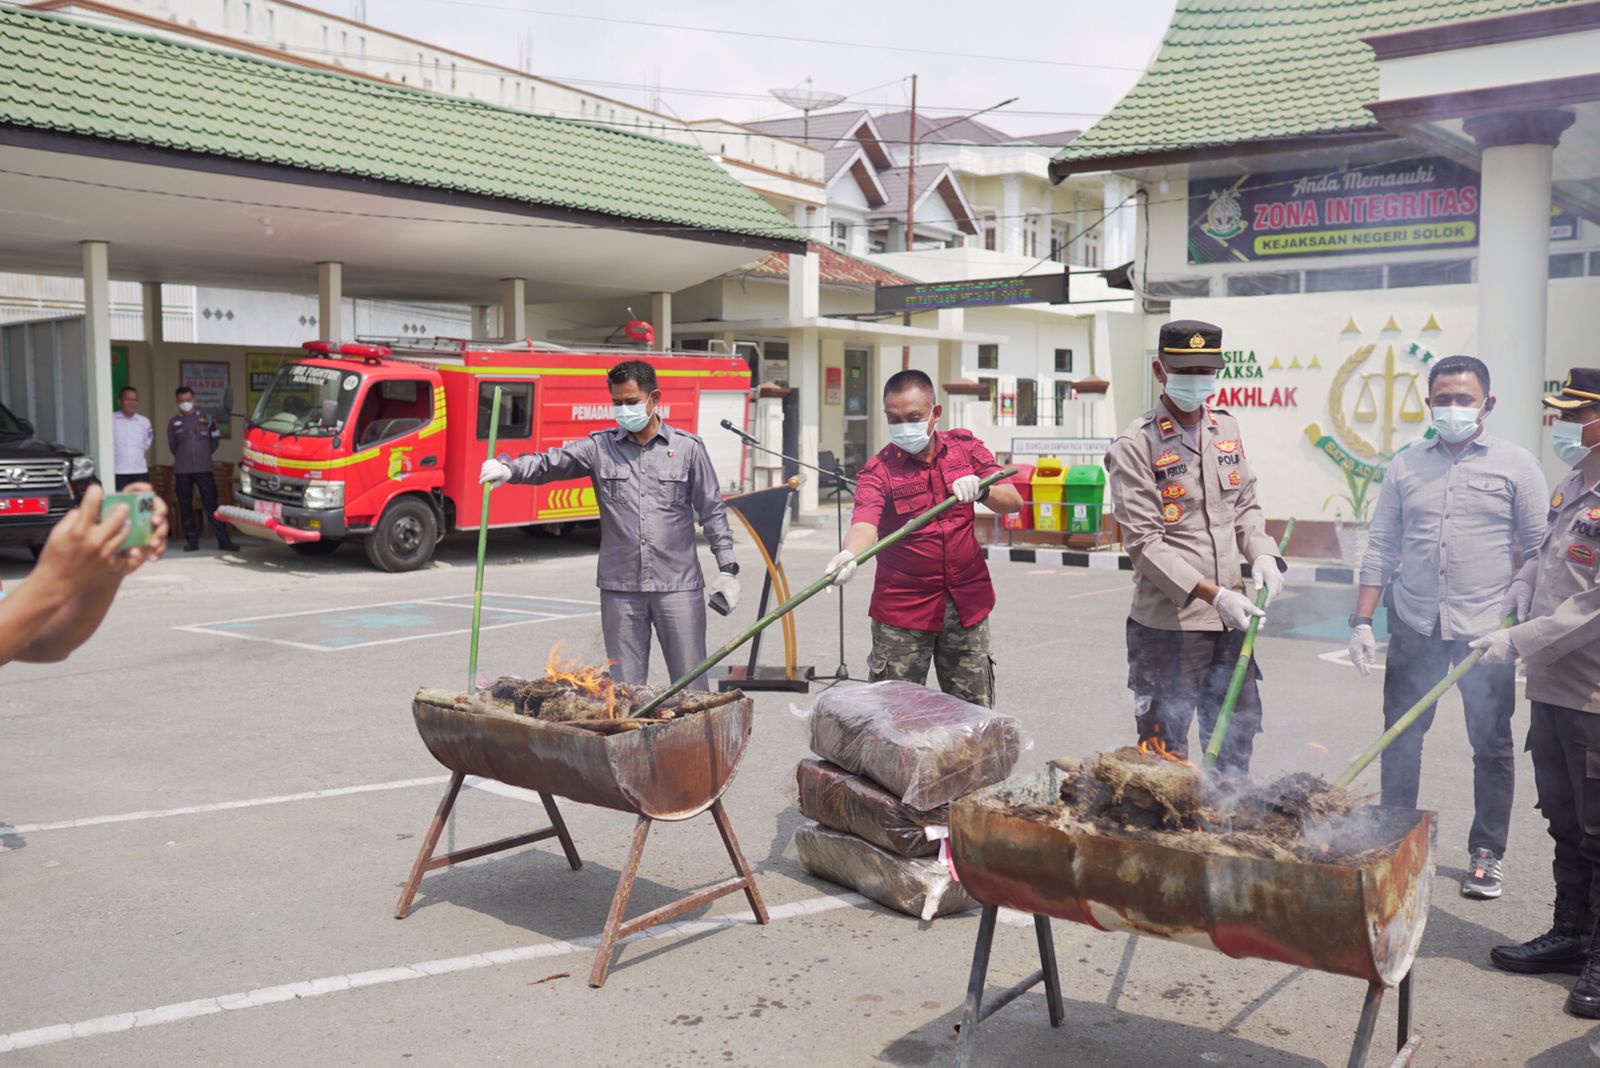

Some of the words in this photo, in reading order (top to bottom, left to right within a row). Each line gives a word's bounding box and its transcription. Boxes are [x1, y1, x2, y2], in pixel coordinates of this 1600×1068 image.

[1292, 175, 1341, 197] Anda
[1343, 165, 1436, 190] Memasuki
[1253, 200, 1319, 231] ZONA
[1325, 186, 1478, 226] INTEGRITAS
[1262, 235, 1347, 250] KEJAKSAAN
[1352, 231, 1407, 244] NEGERI
[1413, 226, 1466, 240] SOLOK
[1223, 350, 1257, 363] SILA
[1571, 519, 1600, 539] POLR
